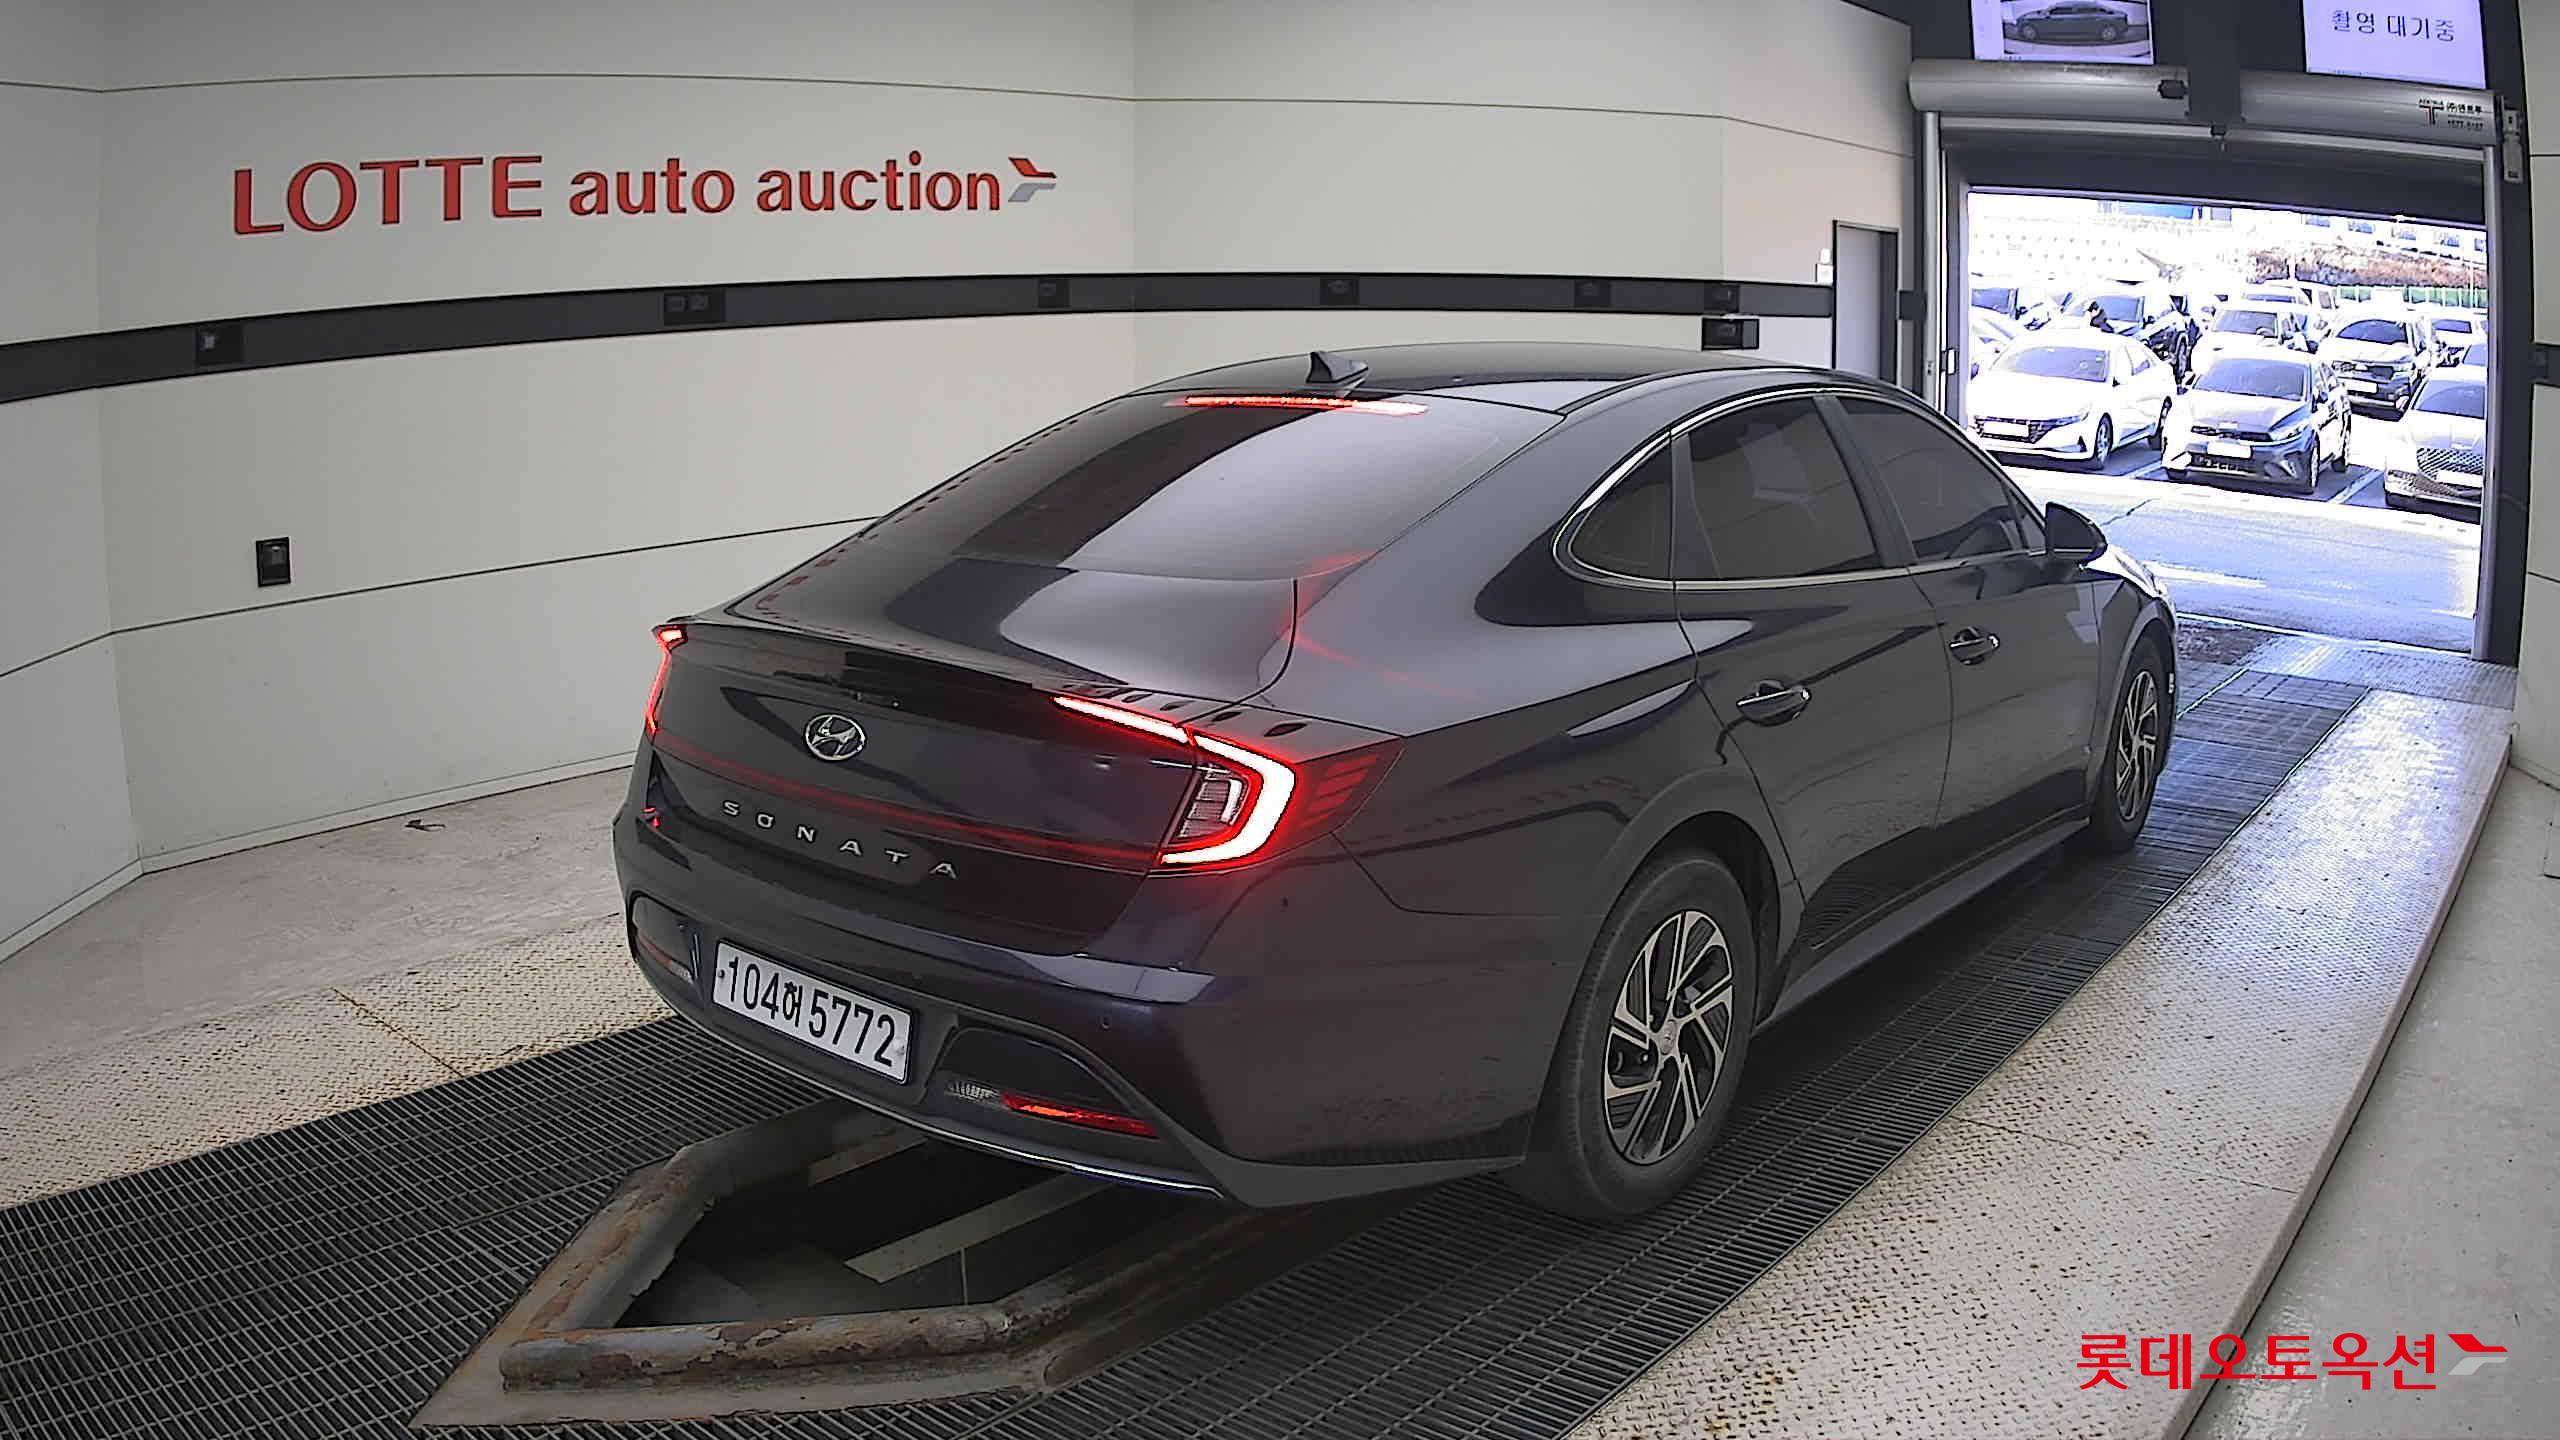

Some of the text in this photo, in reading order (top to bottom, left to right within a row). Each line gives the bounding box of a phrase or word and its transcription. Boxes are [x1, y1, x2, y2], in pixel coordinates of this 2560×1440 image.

[2387, 15, 2455, 42] 대기중
[234, 150, 1001, 235] LOTTE auto auction
[722, 799, 960, 880] SONATA
